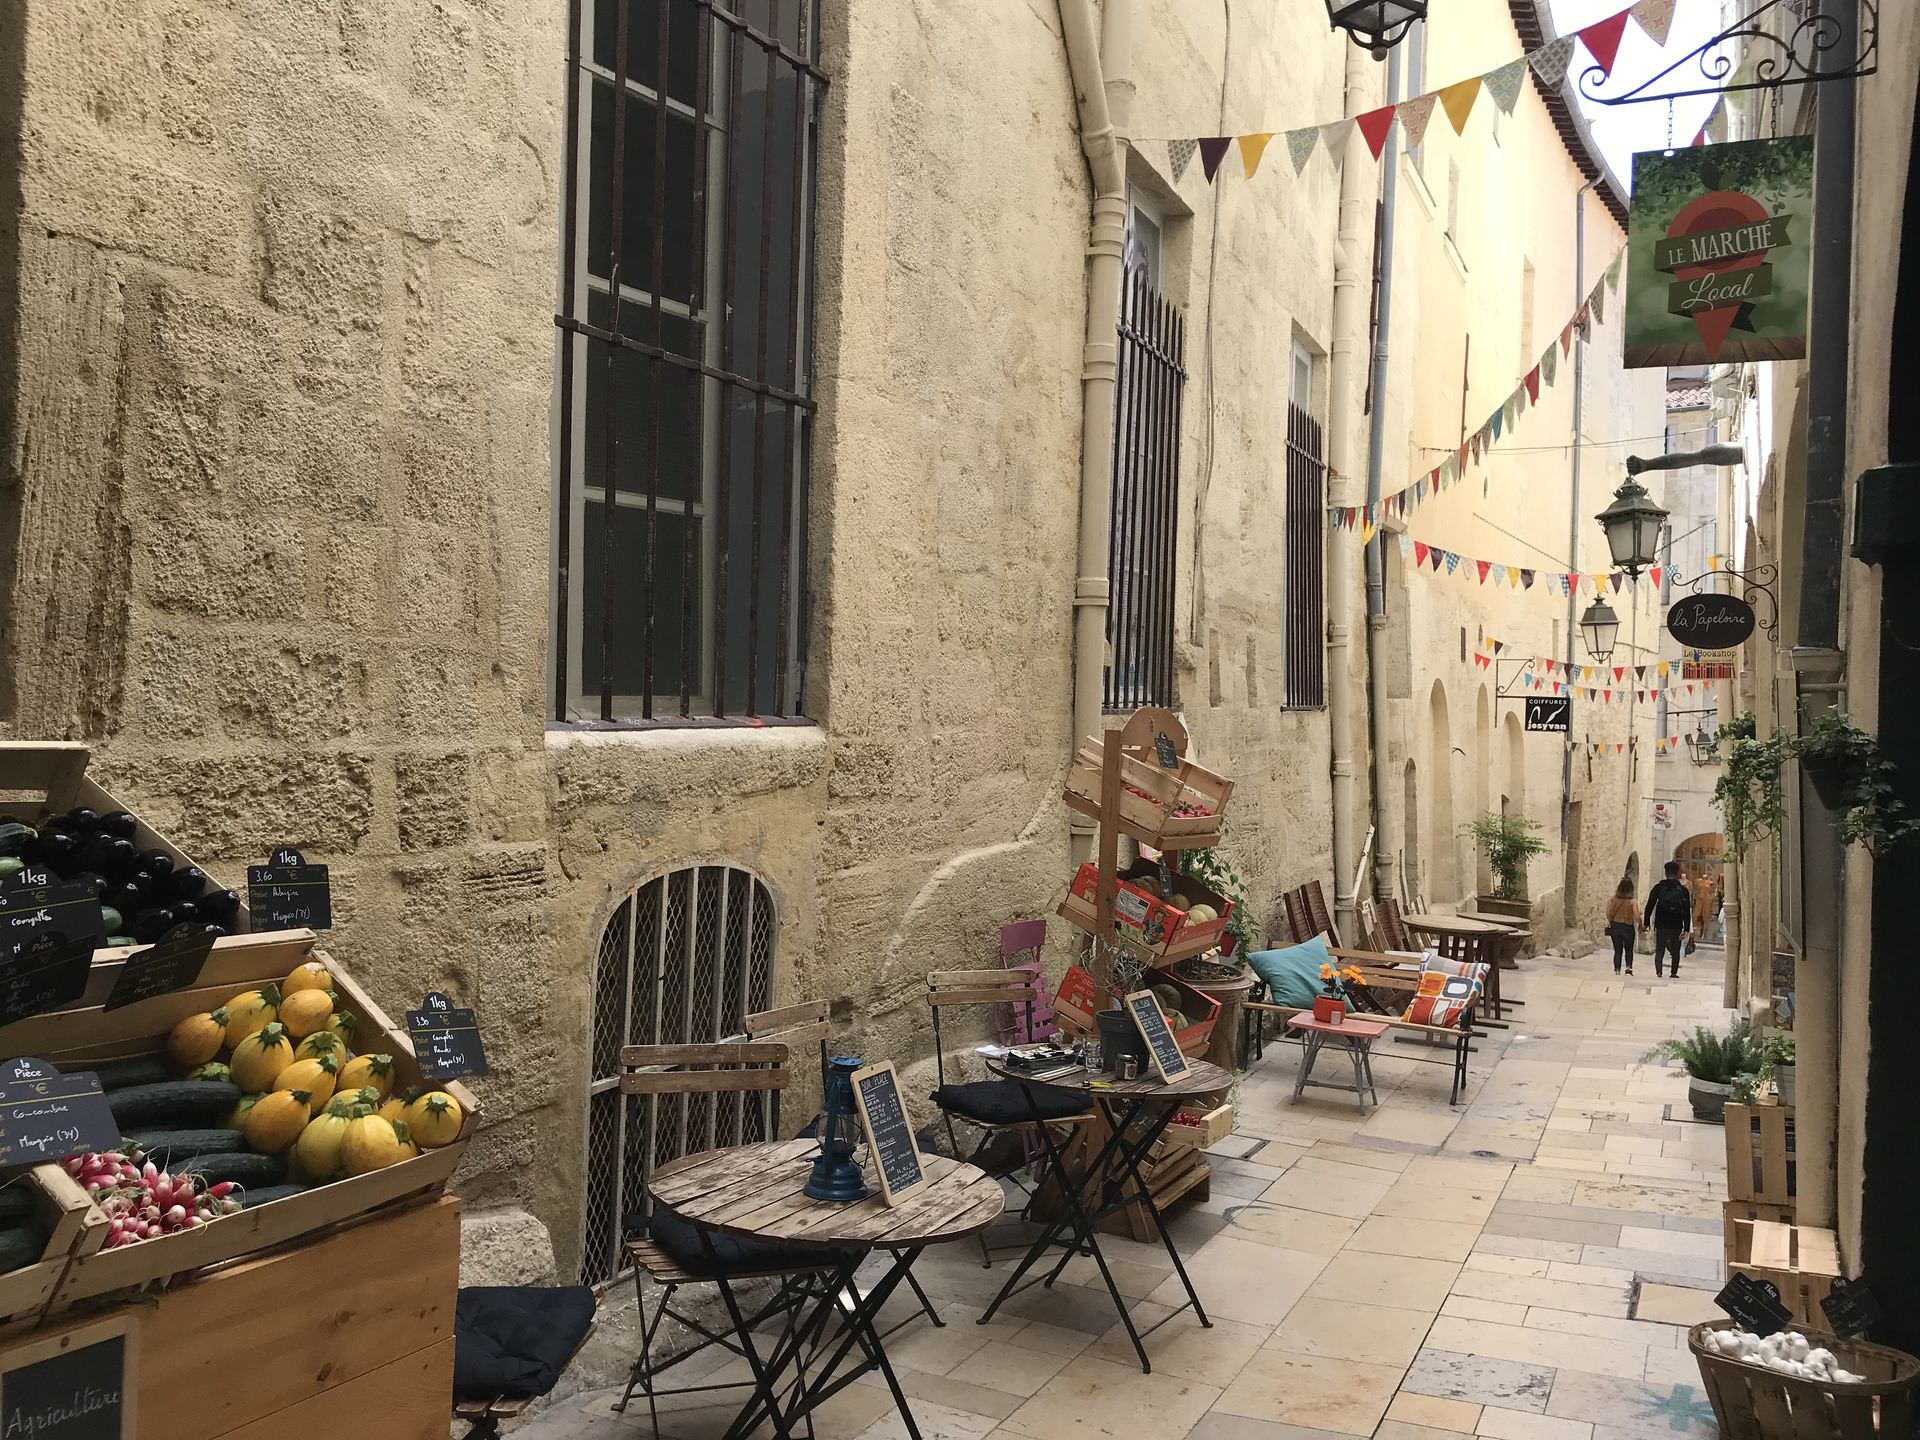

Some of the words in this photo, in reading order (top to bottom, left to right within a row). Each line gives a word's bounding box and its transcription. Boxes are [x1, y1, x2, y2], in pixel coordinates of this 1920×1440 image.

[1668, 247, 1686, 266] LE
[1689, 220, 1777, 263] MARCHÉ
[1681, 272, 1754, 311] Local
[1673, 608, 1689, 627] la
[1690, 603, 1746, 633] Papeloire
[278, 850, 298, 866] 1kg
[18, 868, 48, 886] 1kg
[429, 995, 447, 1011] 1kg
[14, 1067, 43, 1079] Pièce
[6, 1384, 120, 1440] Agriculture
